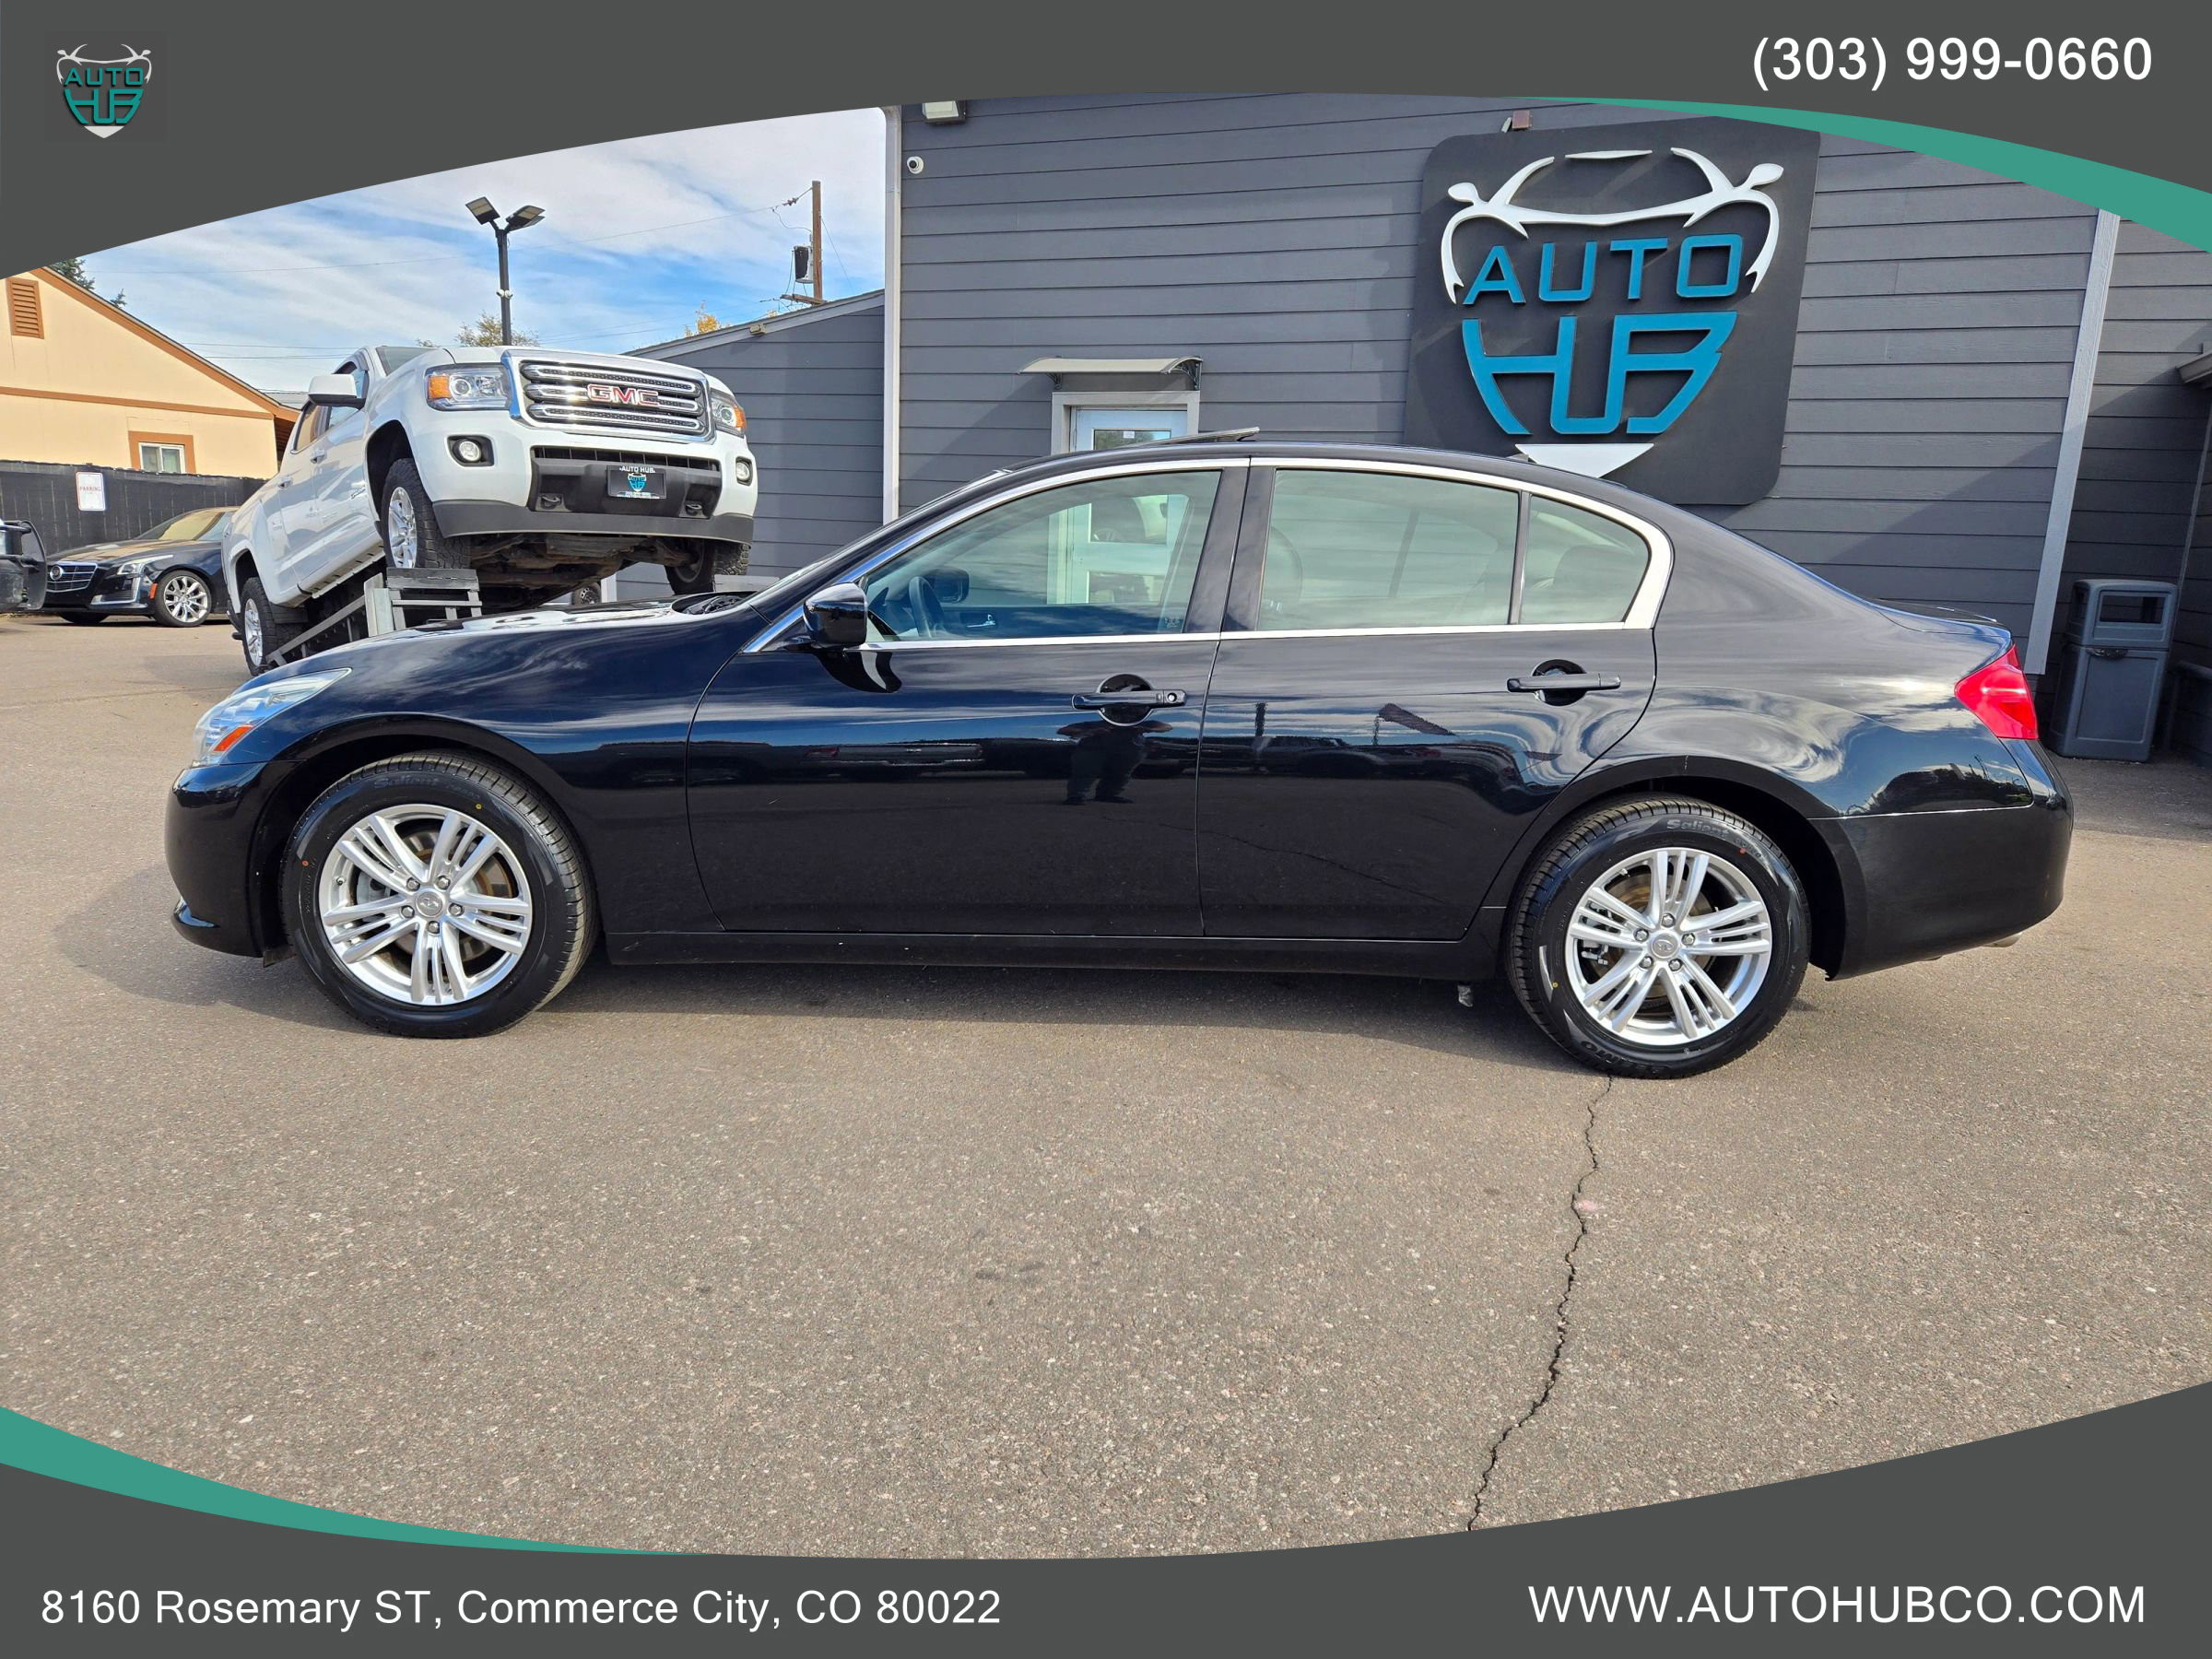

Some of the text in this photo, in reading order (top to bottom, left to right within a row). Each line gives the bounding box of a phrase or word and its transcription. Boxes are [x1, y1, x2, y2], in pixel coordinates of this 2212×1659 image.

[1462, 234, 1744, 306] AUTO
[588, 383, 659, 406] GMC
[1461, 310, 1738, 436] HUB
